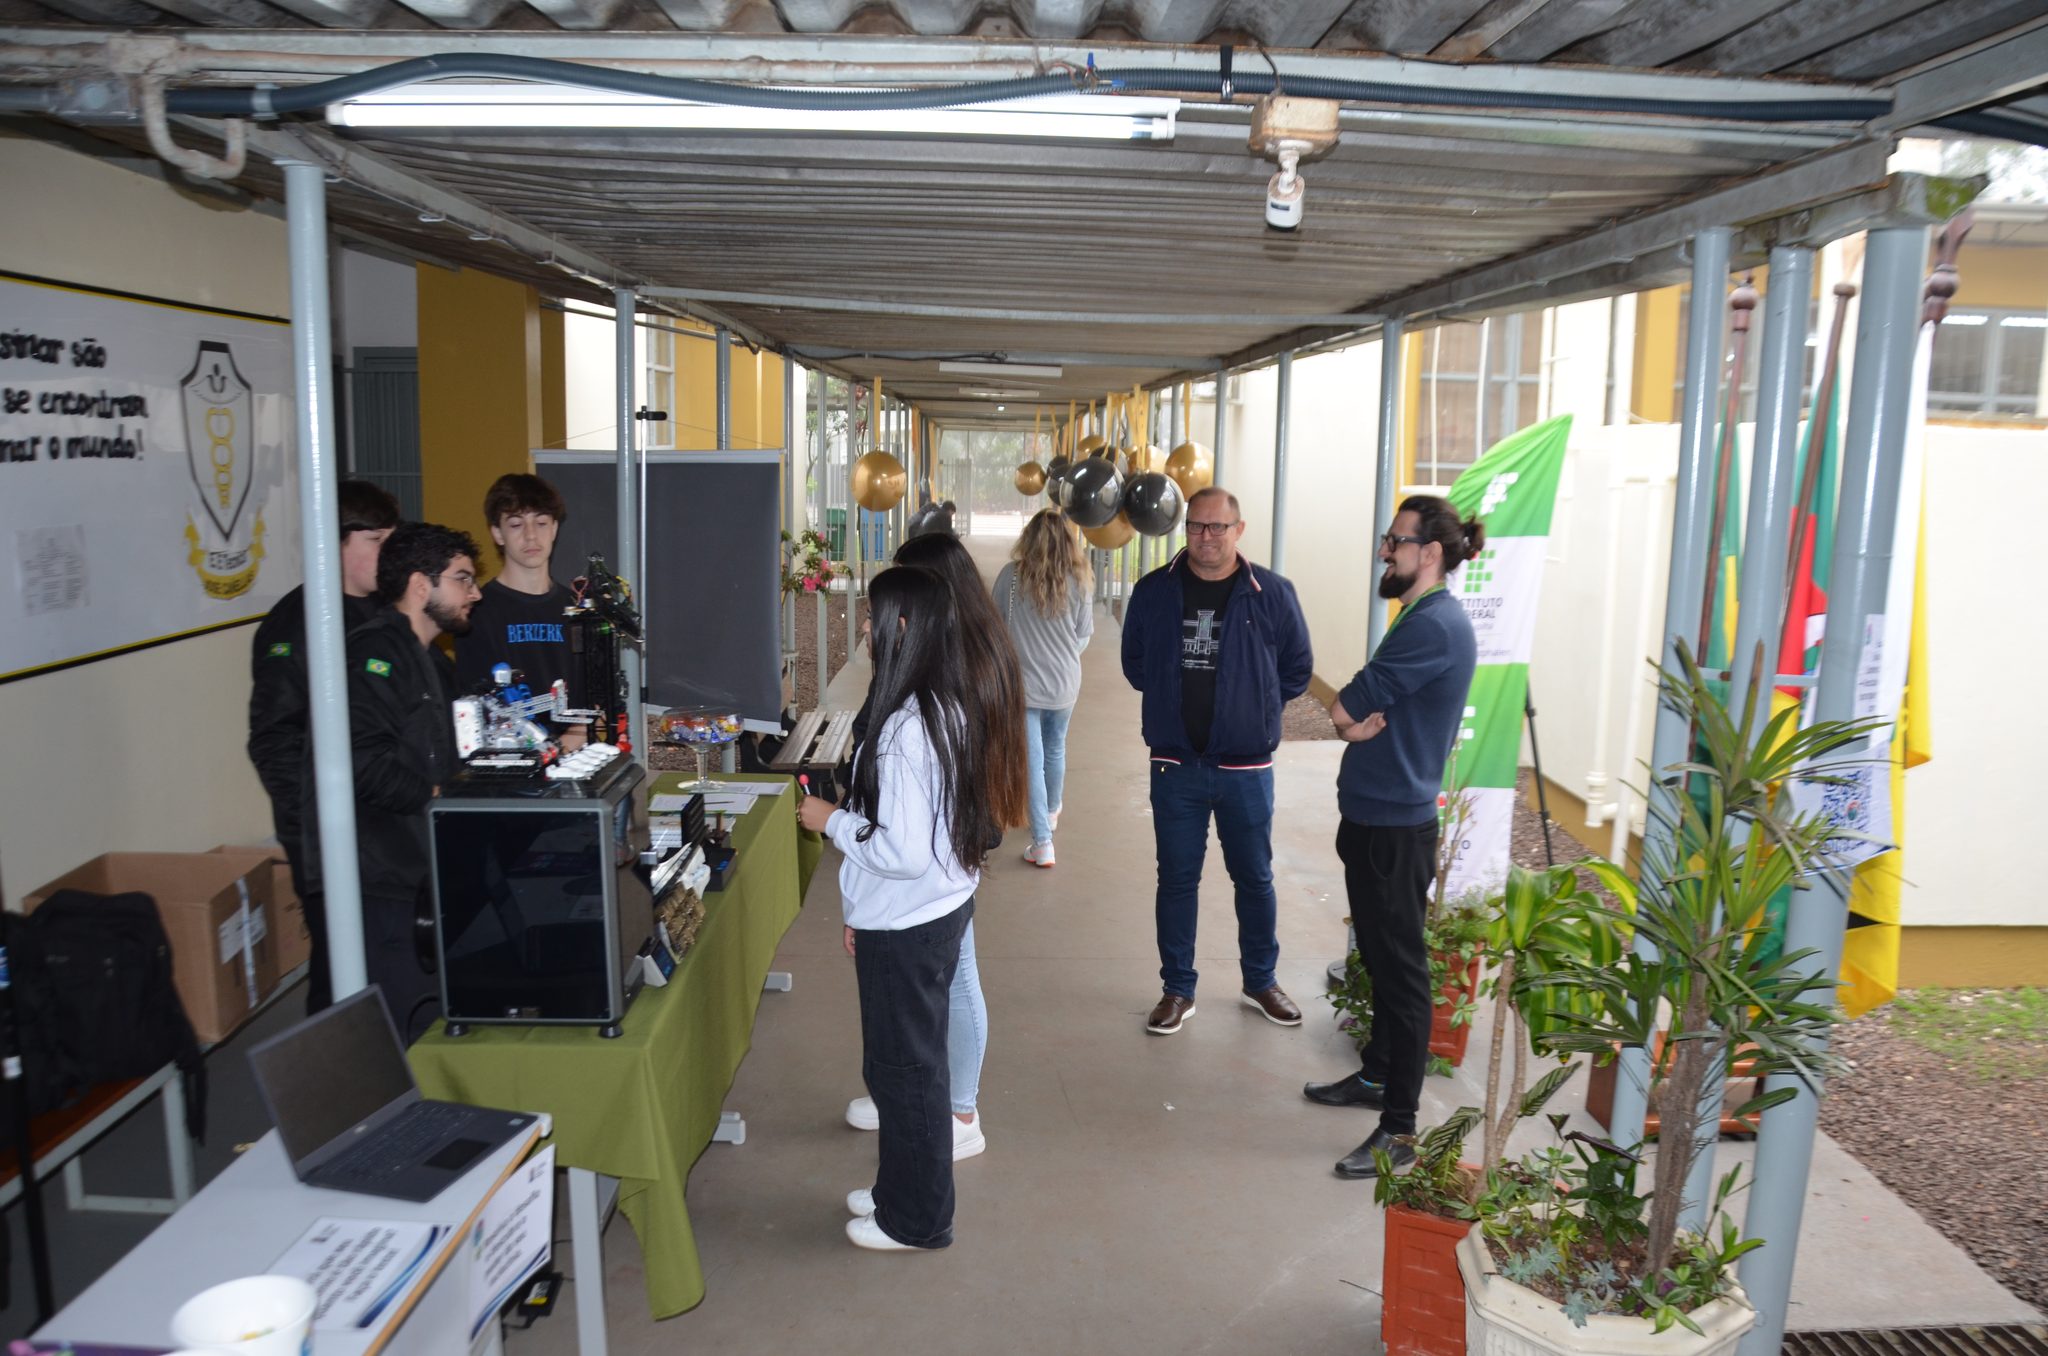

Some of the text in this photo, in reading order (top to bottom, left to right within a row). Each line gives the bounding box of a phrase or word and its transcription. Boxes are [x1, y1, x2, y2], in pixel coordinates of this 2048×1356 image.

[71, 338, 106, 368] são
[4, 387, 30, 414] se
[49, 436, 60, 460] o
[507, 623, 564, 642] BERZERK
